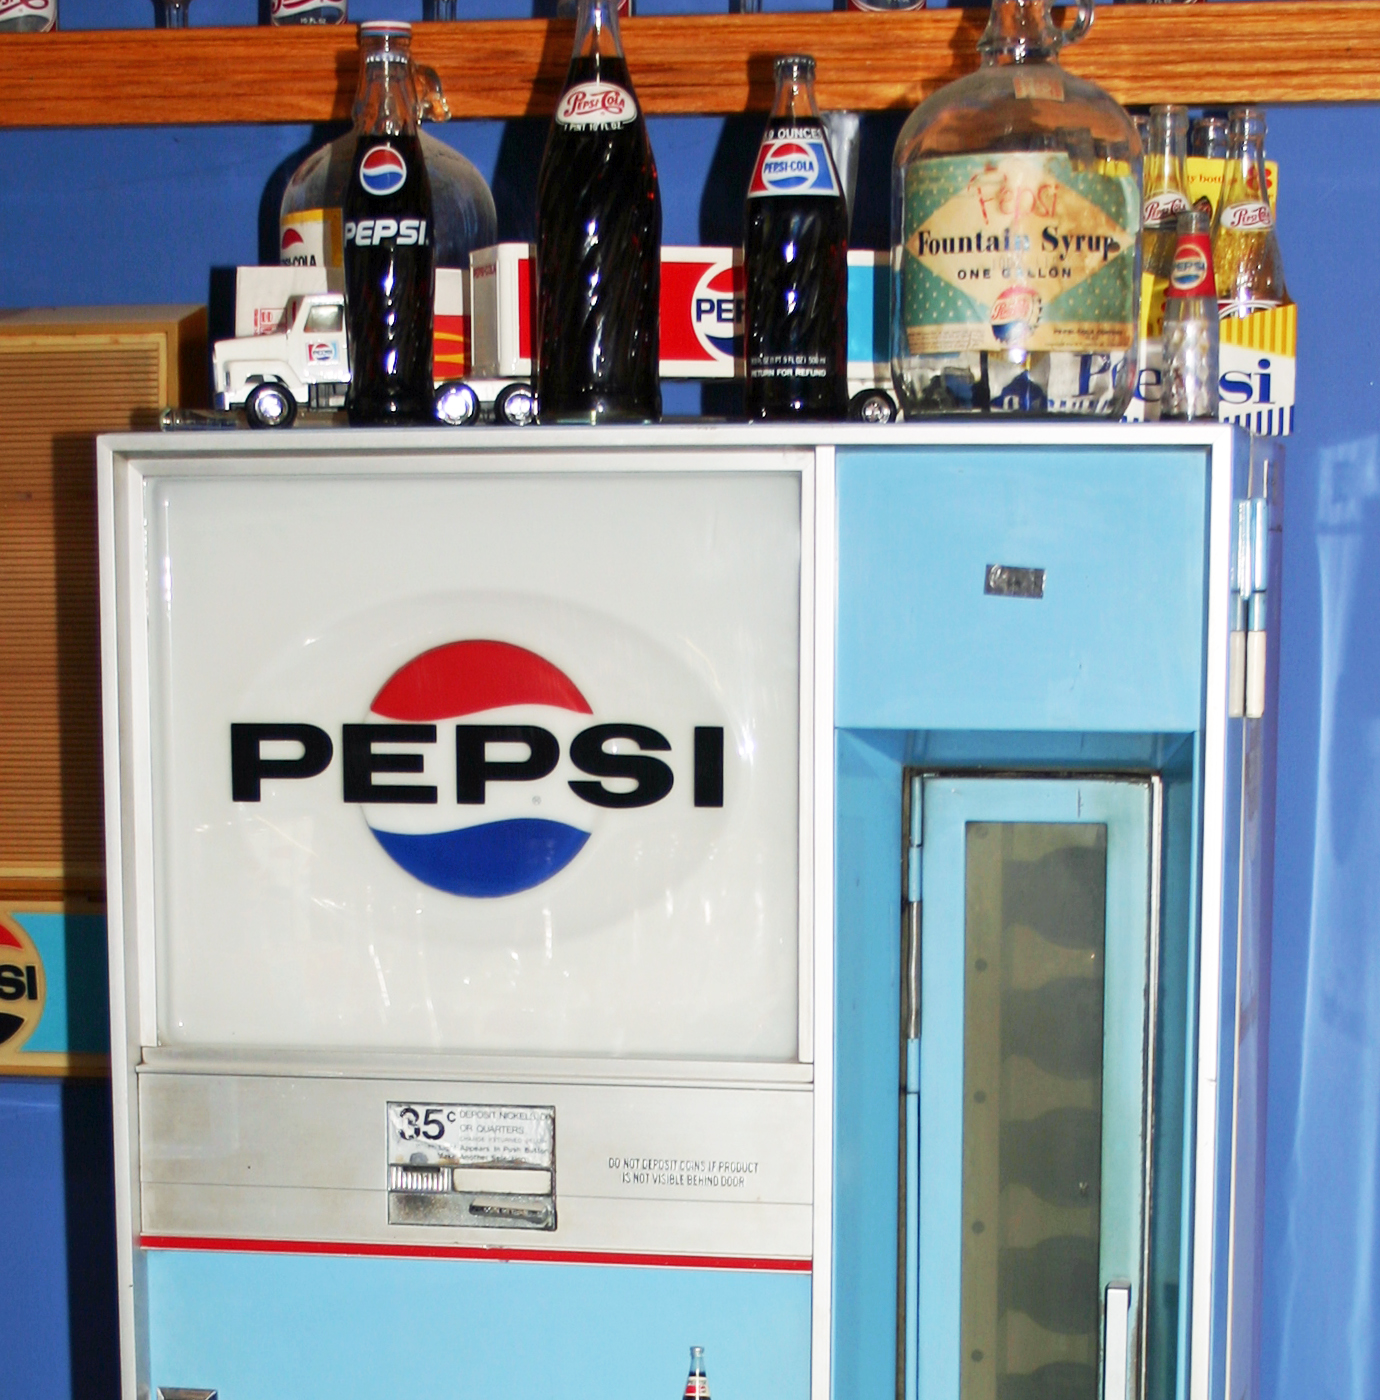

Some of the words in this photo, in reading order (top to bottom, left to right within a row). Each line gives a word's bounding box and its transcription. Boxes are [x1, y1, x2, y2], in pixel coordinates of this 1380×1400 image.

[763, 160, 815, 173] PEPSI-COLA
[344, 219, 427, 247] PEPSI
[917, 228, 1031, 257] Fountain
[1041, 226, 1115, 260] Syrup
[957, 269, 991, 280] ONE
[230, 722, 724, 809] PEPSI
[460, 1124, 473, 1132] OR
[476, 1125, 524, 1135] QUARTERS
[608, 1157, 620, 1169] DO
[623, 1158, 640, 1170] NOT
[642, 1158, 677, 1171] DEPOSIT
[680, 1160, 706, 1172] COINS
[708, 1161, 716, 1172] IF
[718, 1161, 759, 1174] PRODUCT
[622, 1172, 631, 1184] IS
[633, 1173, 650, 1184] NOT
[652, 1174, 684, 1186] VISIBLE
[687, 1175, 719, 1187] BEHIND
[721, 1176, 745, 1187] DOOR
